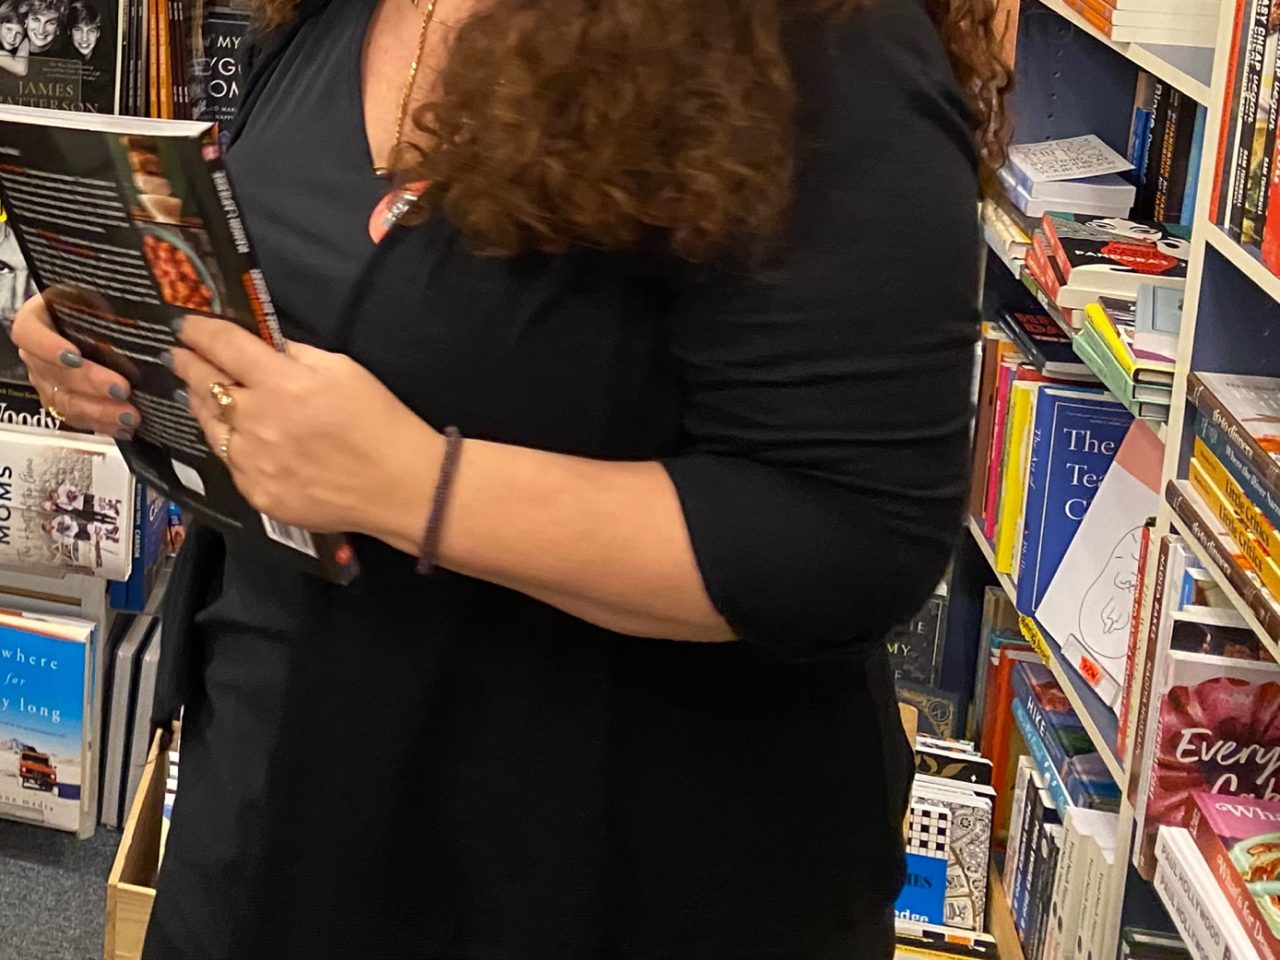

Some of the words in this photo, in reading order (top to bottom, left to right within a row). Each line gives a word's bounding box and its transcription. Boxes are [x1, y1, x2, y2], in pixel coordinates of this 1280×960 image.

[1063, 428, 1115, 455] The
[20, 697, 62, 724] long
[1027, 696, 1046, 737] HIKE
[1161, 844, 1178, 878] PAUL
[1179, 874, 1220, 946] HOLLYWOOD
